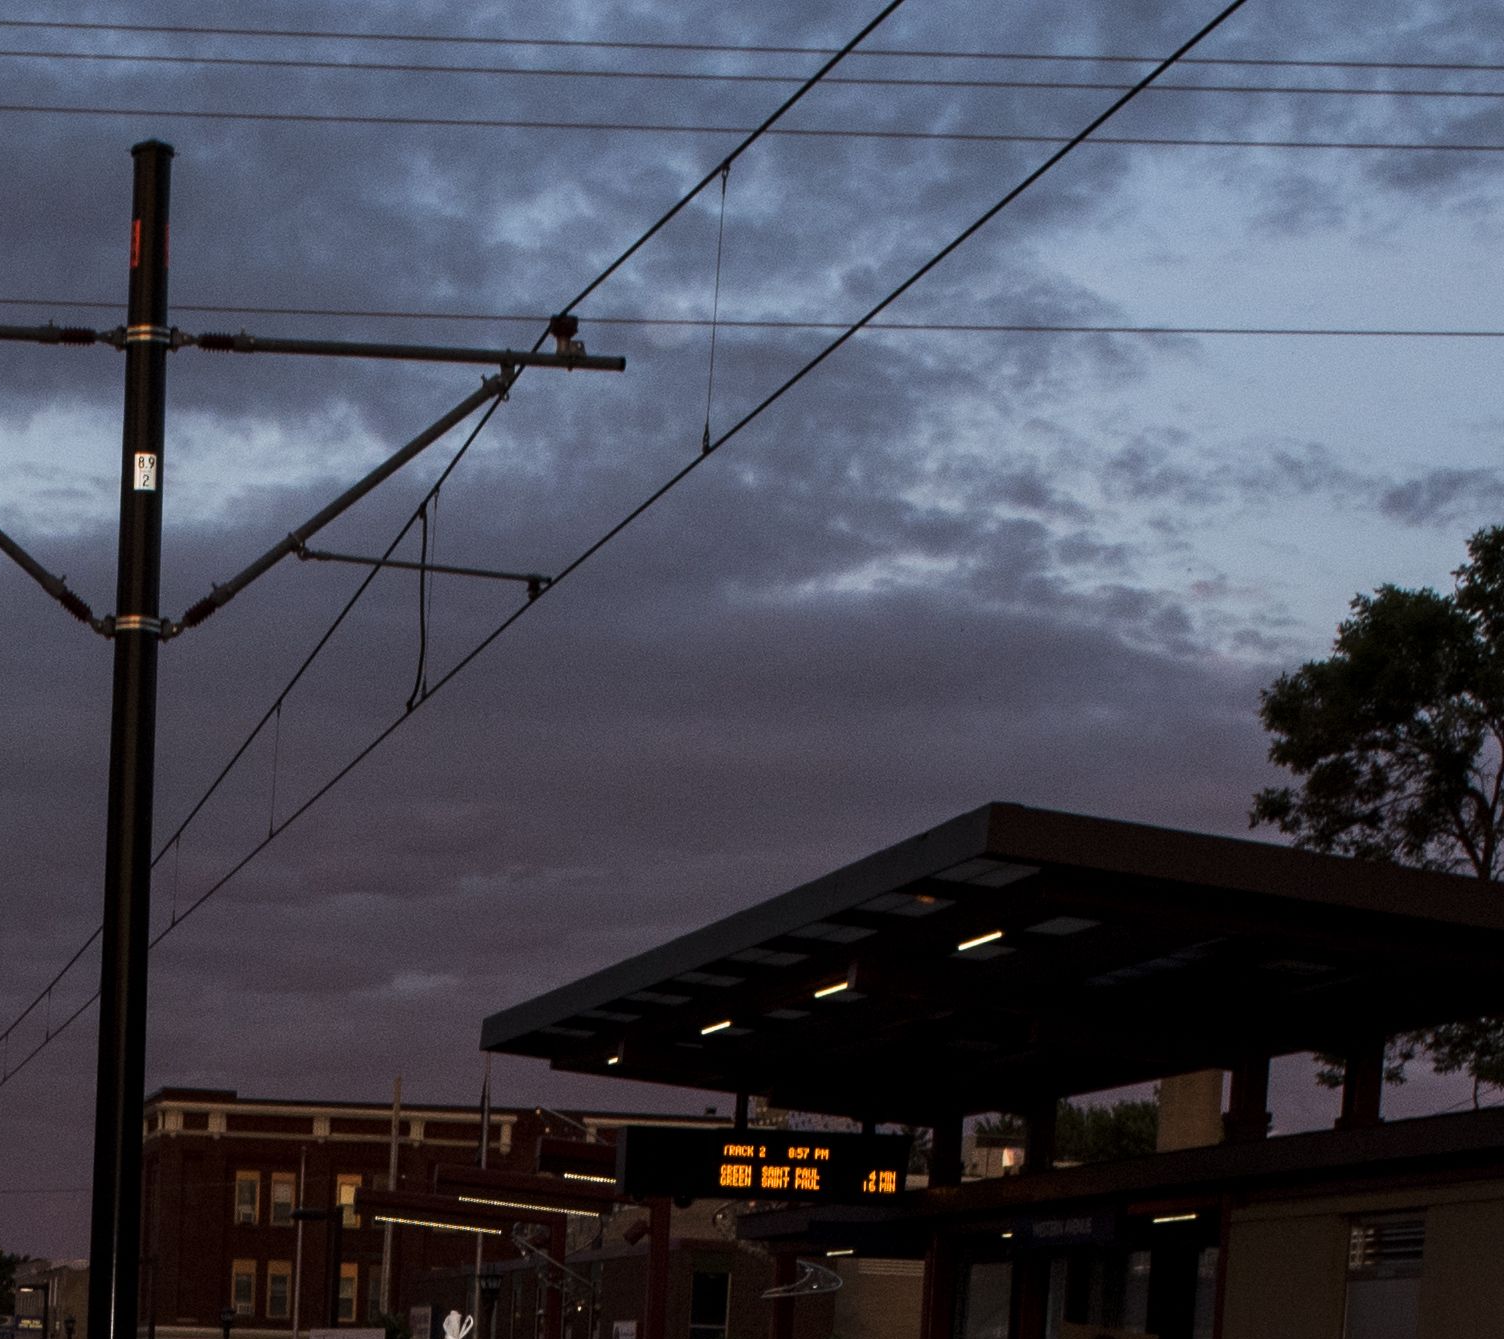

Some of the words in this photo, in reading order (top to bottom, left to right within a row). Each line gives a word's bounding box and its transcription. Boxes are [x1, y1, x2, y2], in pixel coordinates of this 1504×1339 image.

[723, 1144, 755, 1158] TRACK
[758, 1145, 767, 1159] 2
[814, 1148, 830, 1161] PM
[721, 1164, 752, 1176] GREEN
[761, 1166, 791, 1177] SAINT
[795, 1167, 820, 1179] PAUL
[720, 1174, 752, 1187] GREEN
[761, 1176, 790, 1188] SAINT
[795, 1178, 820, 1190] PAUL
